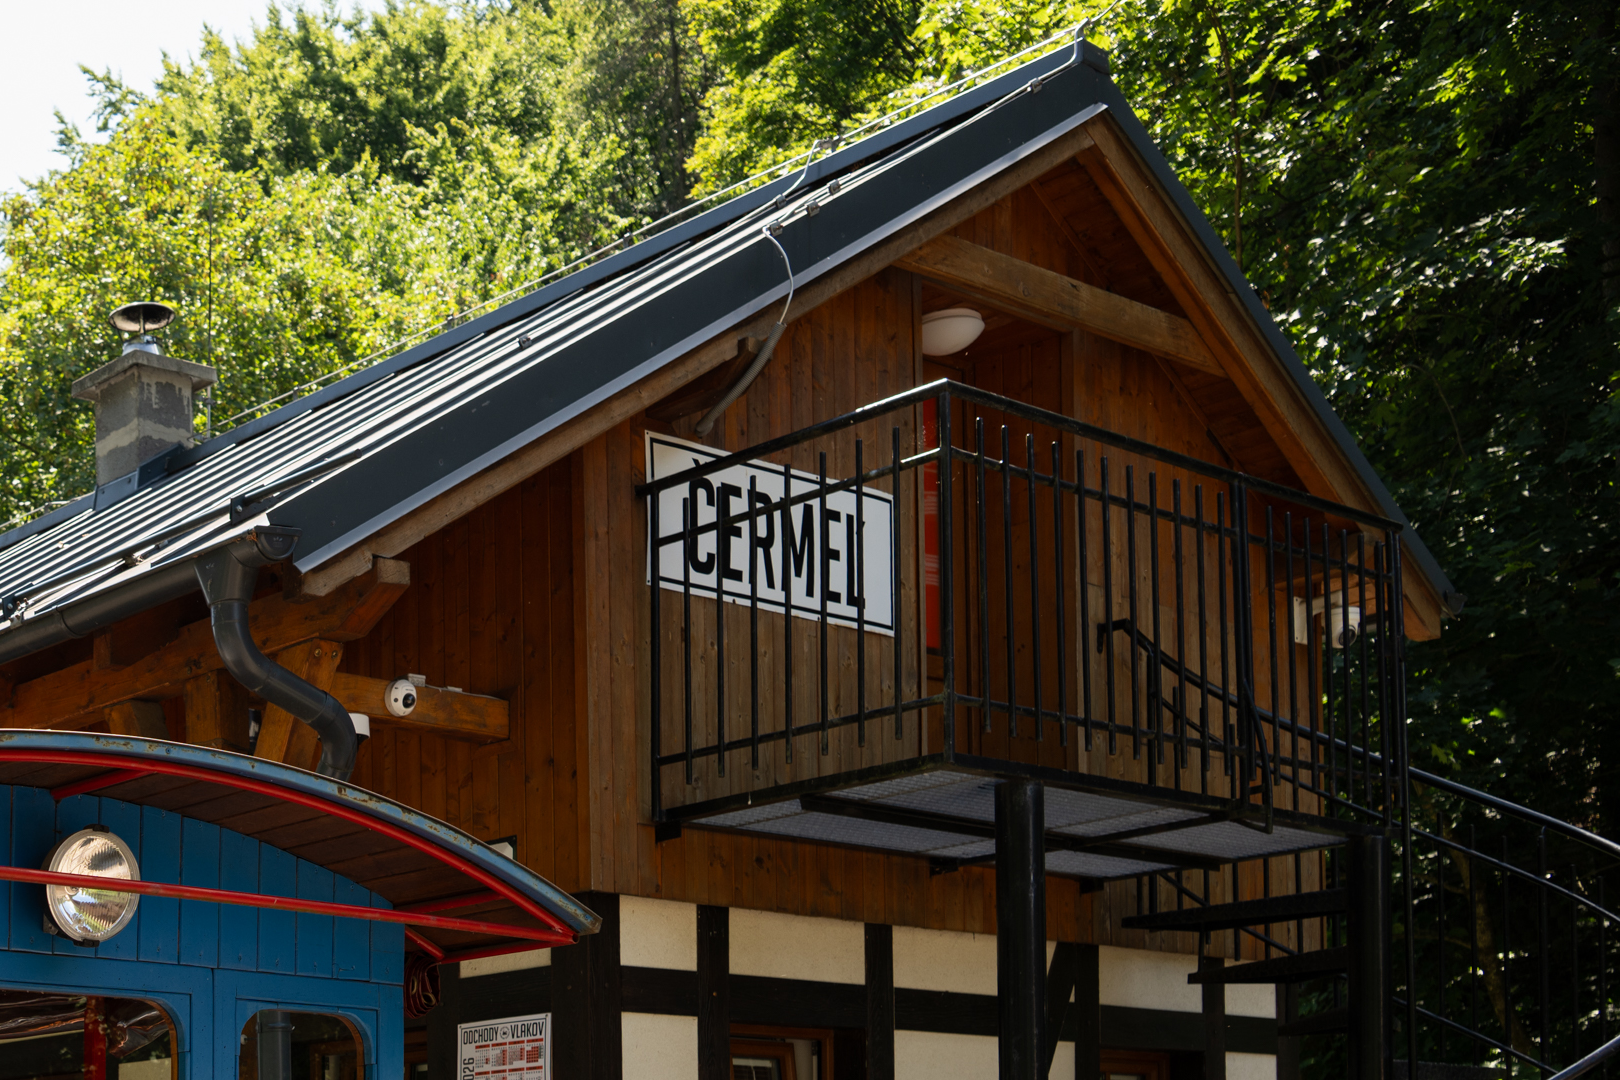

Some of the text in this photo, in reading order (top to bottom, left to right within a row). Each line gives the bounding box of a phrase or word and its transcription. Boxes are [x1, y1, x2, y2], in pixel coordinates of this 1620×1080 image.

[688, 457, 866, 610] ČERMEĽ
[463, 1021, 544, 1045] ODCHODY VLAKOV
